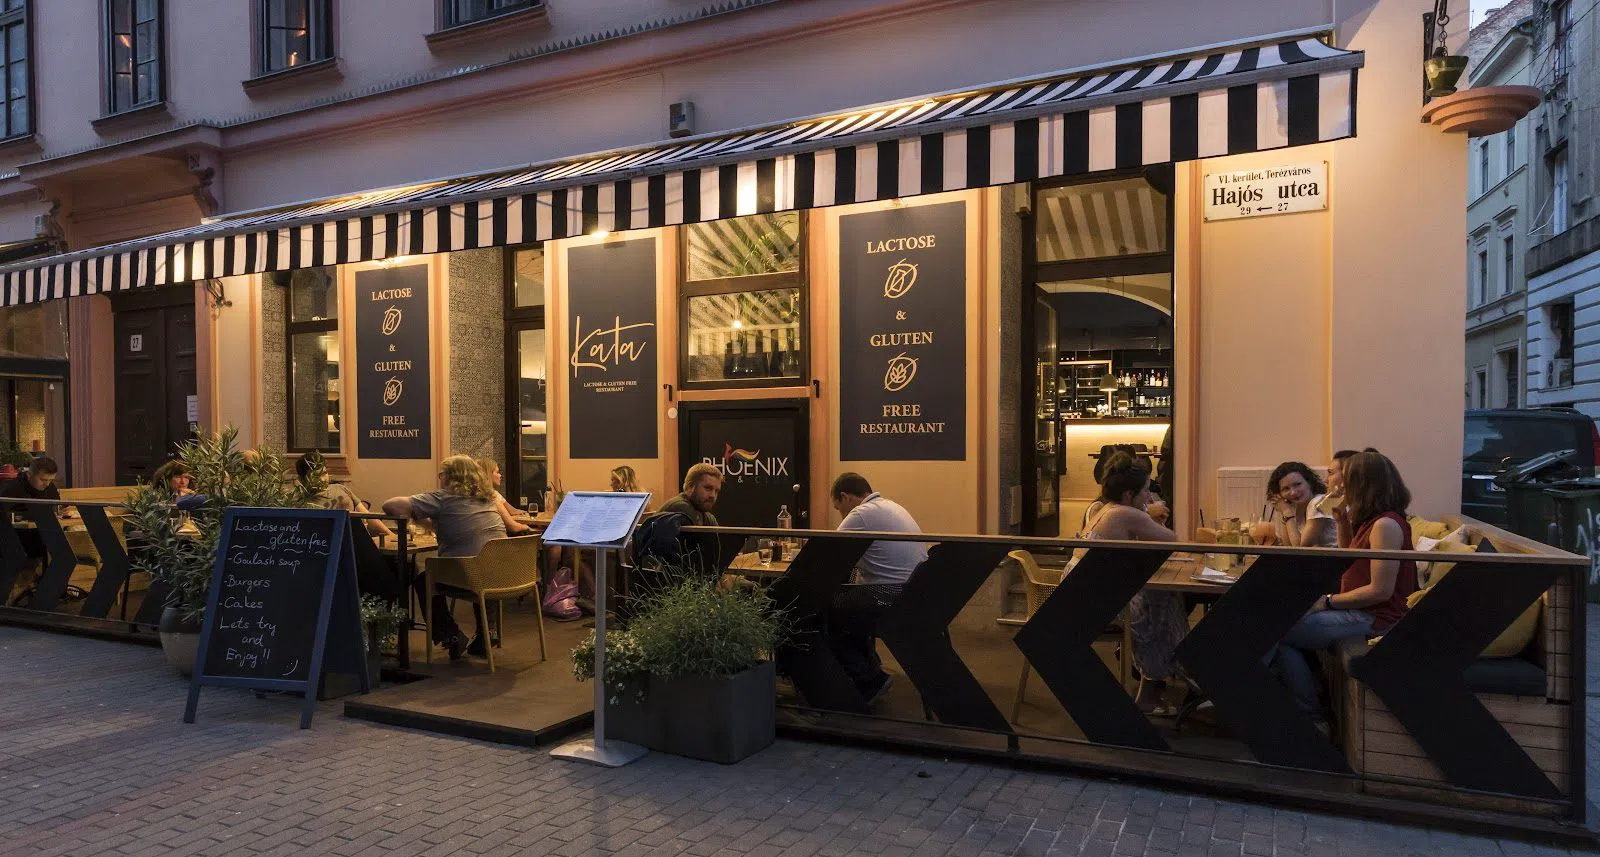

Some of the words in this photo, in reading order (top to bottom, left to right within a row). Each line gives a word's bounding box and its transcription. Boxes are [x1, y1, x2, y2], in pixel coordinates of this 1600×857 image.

[1218, 175, 1231, 184] VI.
[1265, 166, 1311, 179] Terézváros
[1212, 185, 1264, 207] Hajós
[1278, 180, 1320, 199] utca
[1240, 206, 1251, 215] 29
[1277, 202, 1289, 211] 27
[866, 234, 936, 254] LACTOSE
[372, 287, 412, 301] LACTOSE
[895, 310, 907, 320] &
[132, 337, 140, 349] 27
[870, 331, 933, 347] GLUTEN
[389, 343, 396, 352] &
[570, 315, 655, 378] Kata
[374, 360, 412, 372] GLUTEN
[882, 404, 921, 417] FREE
[382, 415, 406, 425] FREE
[369, 429, 419, 438] RESTAURANT
[859, 422, 945, 434] RESTAURANT
[234, 519, 278, 532] Lactose
[279, 521, 301, 533] and
[269, 532, 307, 550] gluten
[307, 532, 328, 550] free
[278, 558, 301, 575] soup
[219, 615, 250, 630] Lets
[256, 616, 277, 637] try
[241, 634, 264, 647] and
[226, 647, 258, 668] Enjoy
